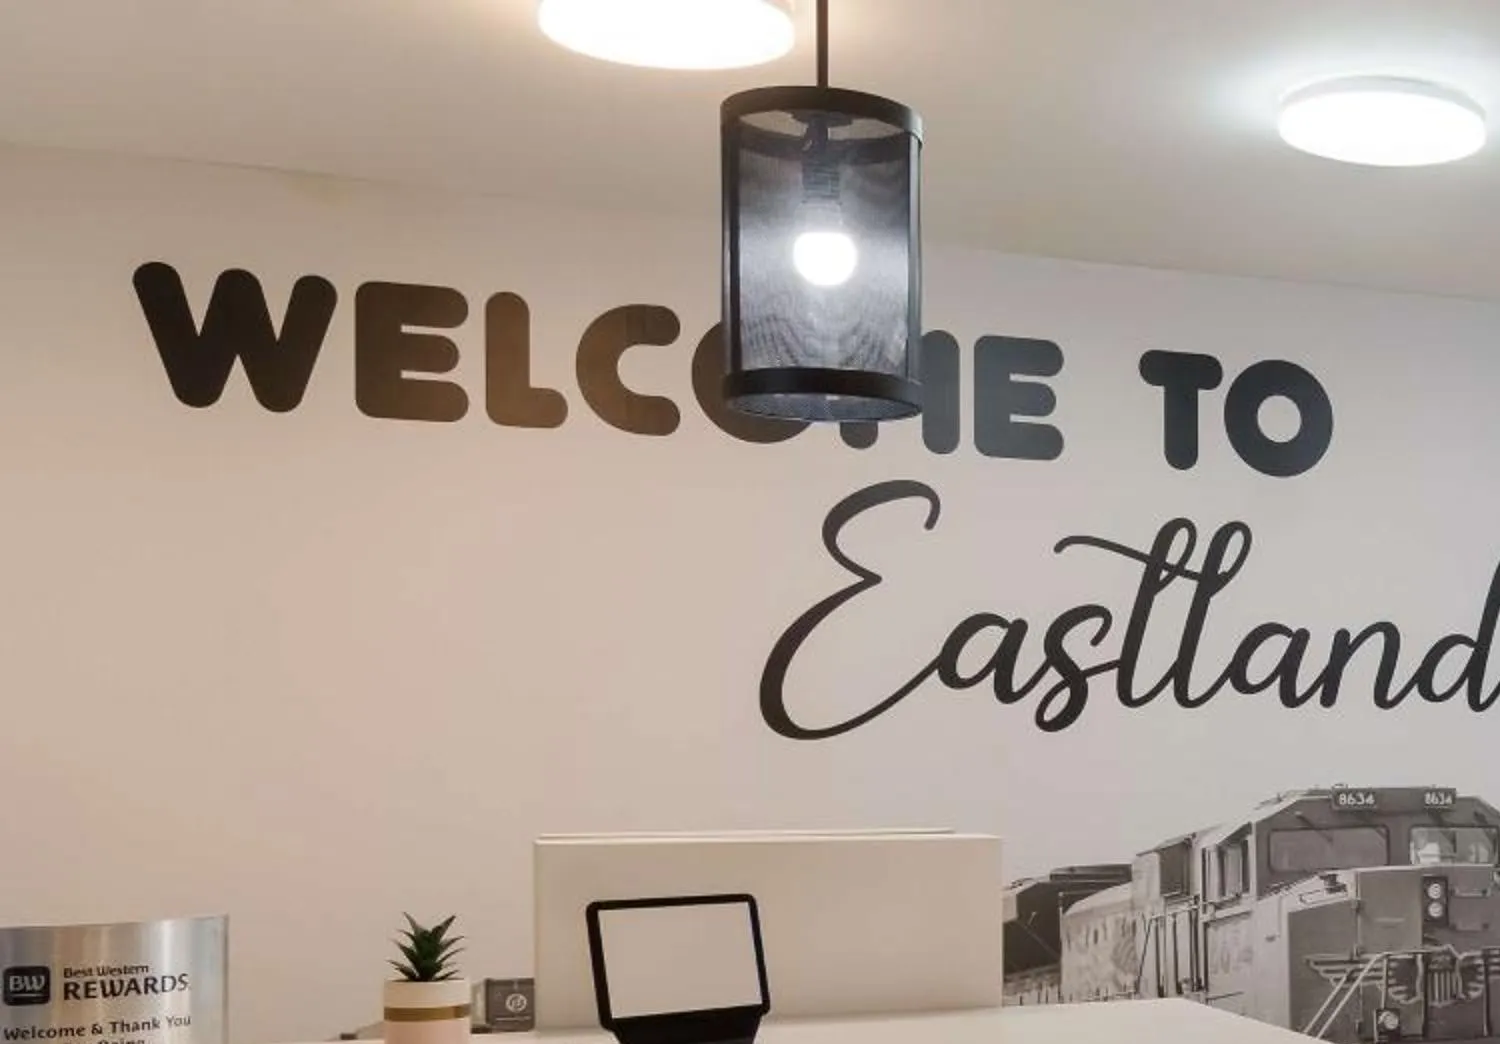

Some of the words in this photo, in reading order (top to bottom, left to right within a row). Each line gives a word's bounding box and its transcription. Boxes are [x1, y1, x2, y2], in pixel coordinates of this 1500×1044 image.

[1138, 350, 1333, 477] TO
[1337, 792, 1376, 806] 8634
[63, 967, 93, 979] Best
[97, 964, 149, 977] Western
[9, 975, 45, 992] BW
[63, 973, 189, 1001] REWARDS
[3, 1025, 86, 1041] Welcome
[91, 1023, 103, 1037] &
[110, 1018, 160, 1034] Thank
[165, 1015, 191, 1028] You
